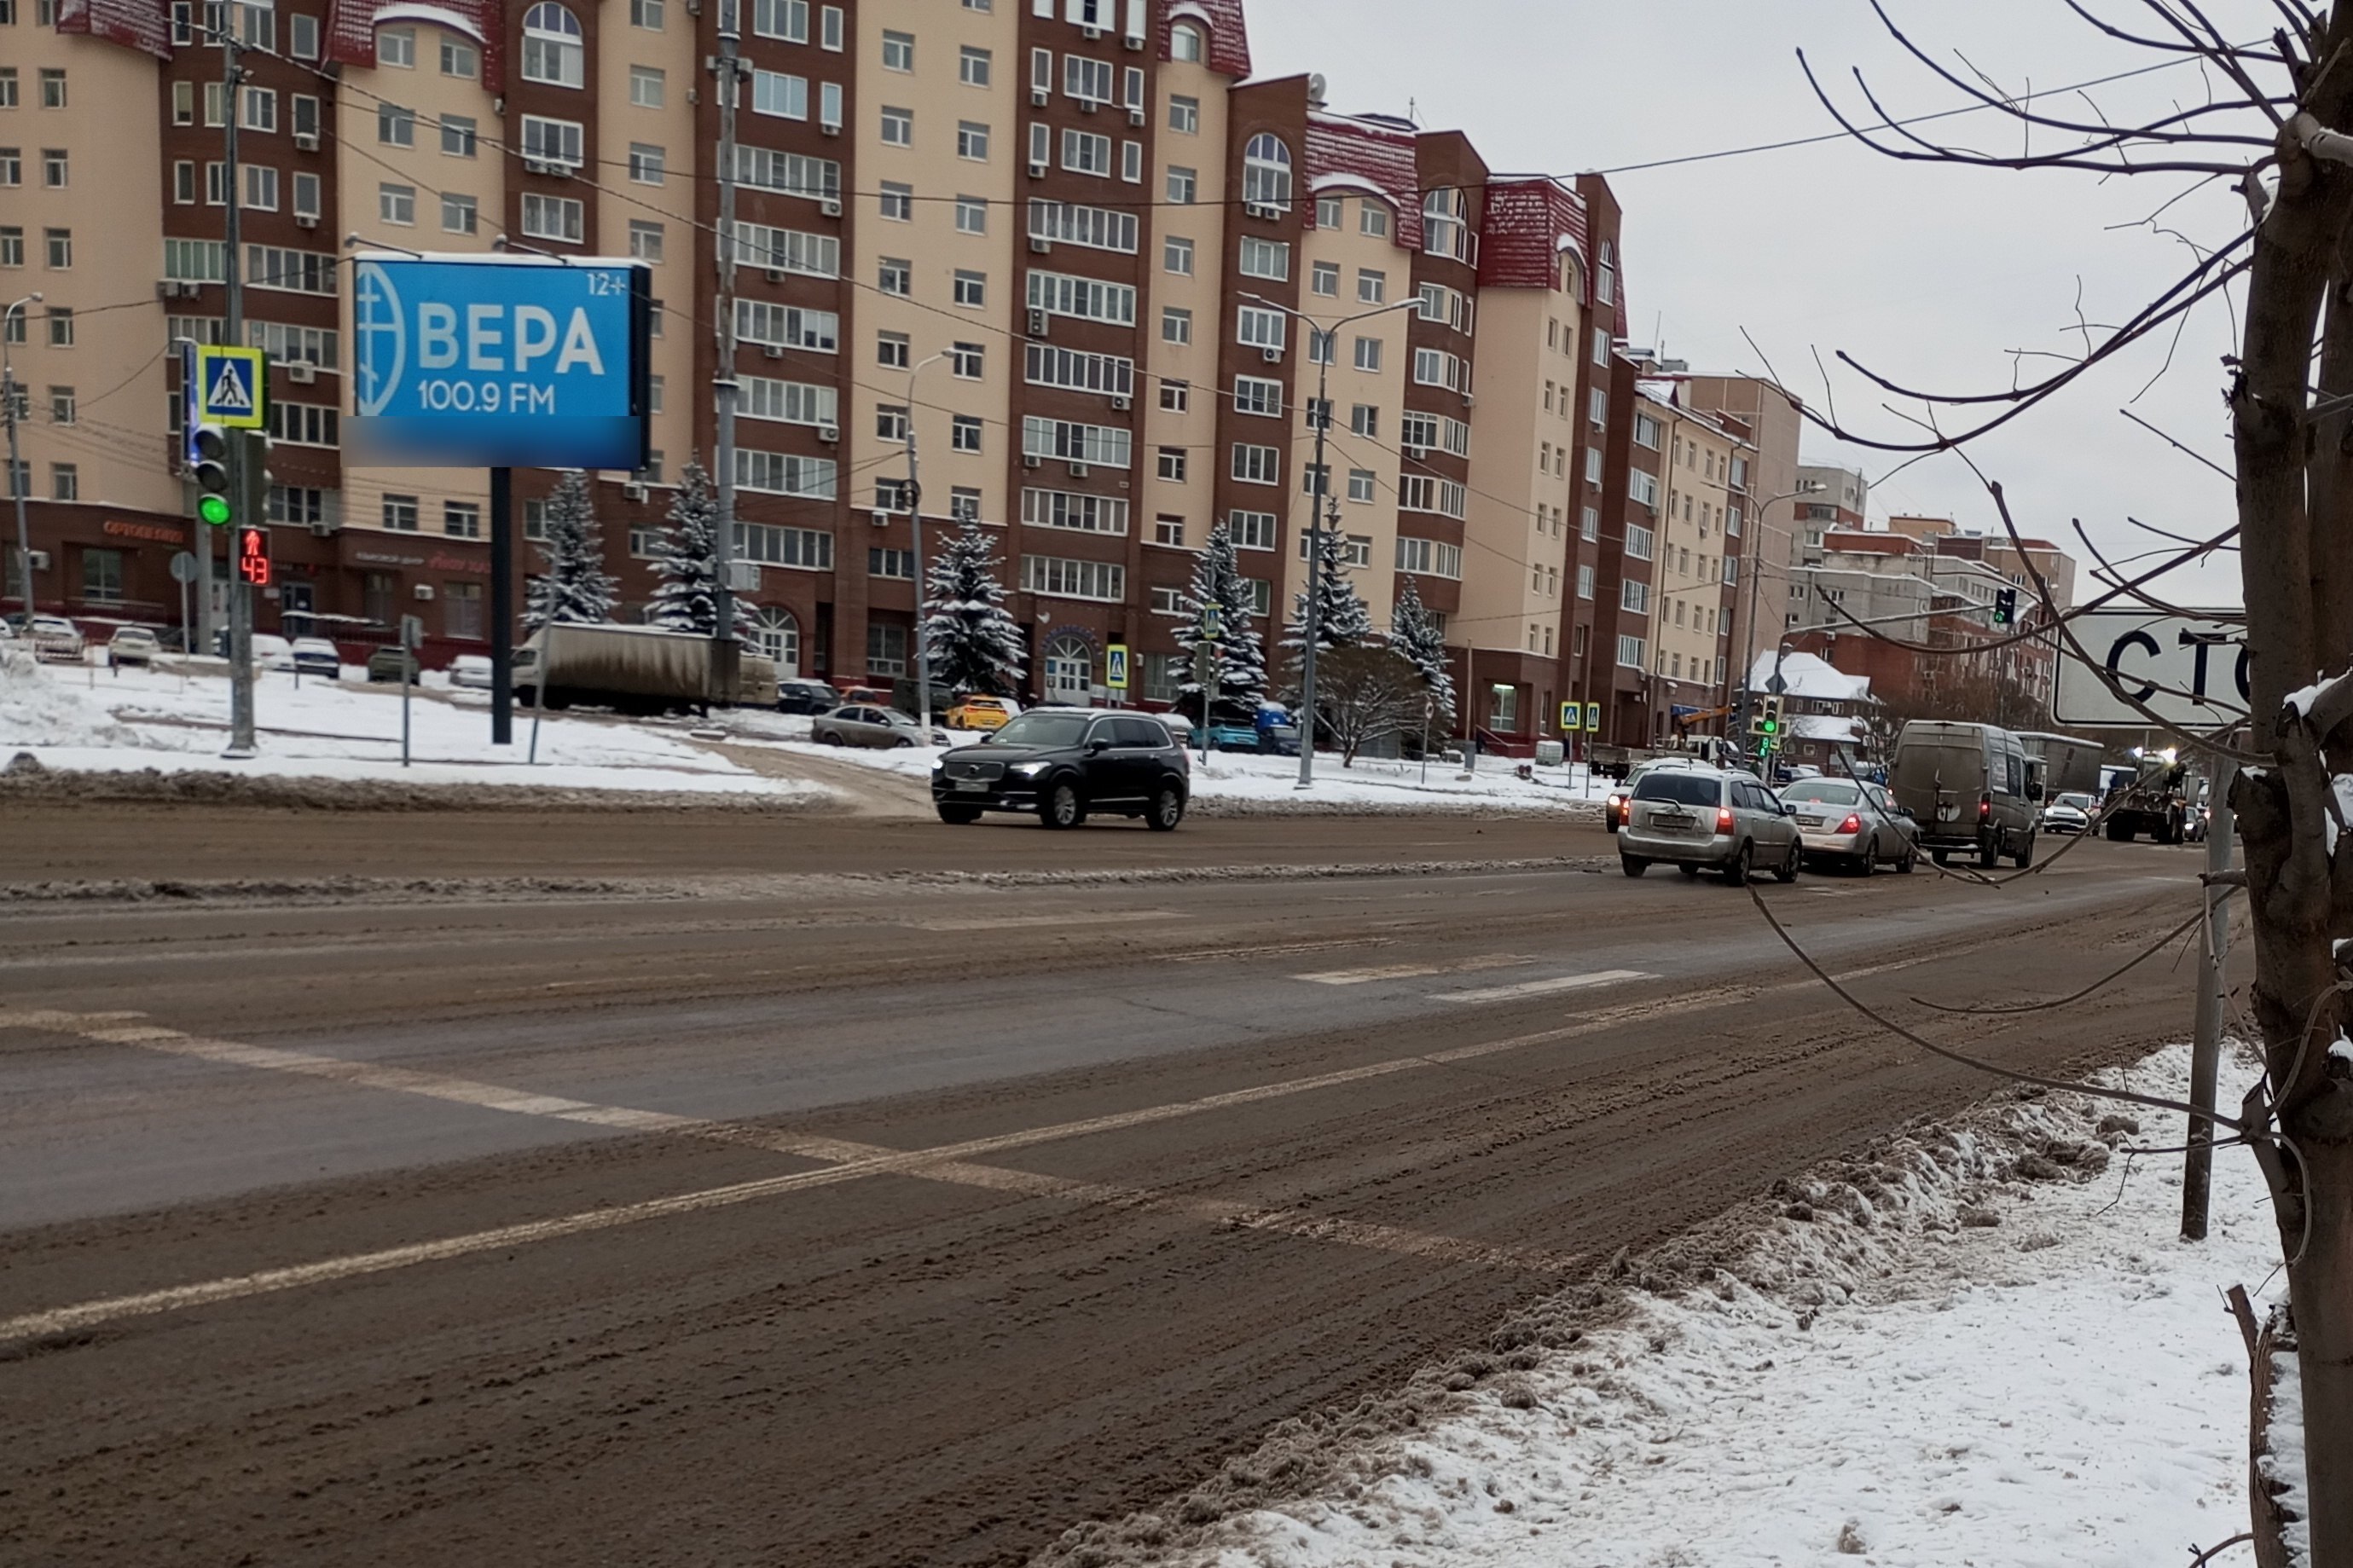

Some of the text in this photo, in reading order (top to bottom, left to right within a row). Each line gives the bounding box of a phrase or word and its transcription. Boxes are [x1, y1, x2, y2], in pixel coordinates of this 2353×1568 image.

[587, 273, 626, 295] 12+
[419, 302, 605, 375] ВЕРА
[418, 379, 554, 415] 100.9 FM
[241, 557, 268, 584] 43
